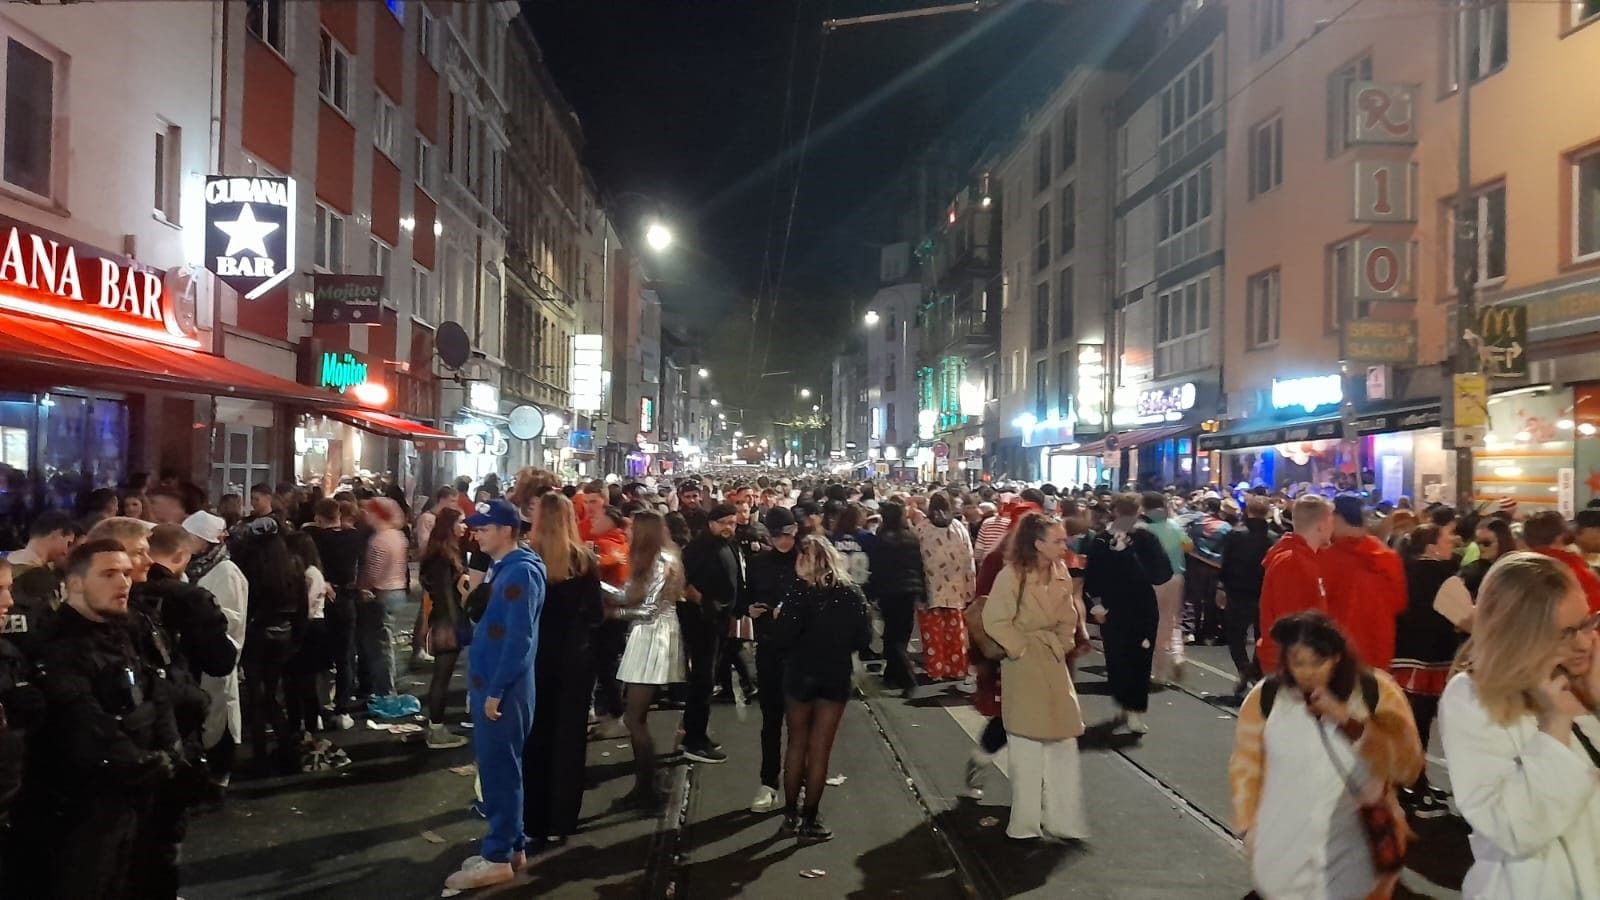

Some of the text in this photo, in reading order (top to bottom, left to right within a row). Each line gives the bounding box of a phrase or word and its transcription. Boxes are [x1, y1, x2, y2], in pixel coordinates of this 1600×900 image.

[205, 178, 287, 207] CUBANA
[0, 226, 162, 321] ANA BAR
[216, 256, 275, 277] BAR
[316, 283, 378, 301] Mojitos
